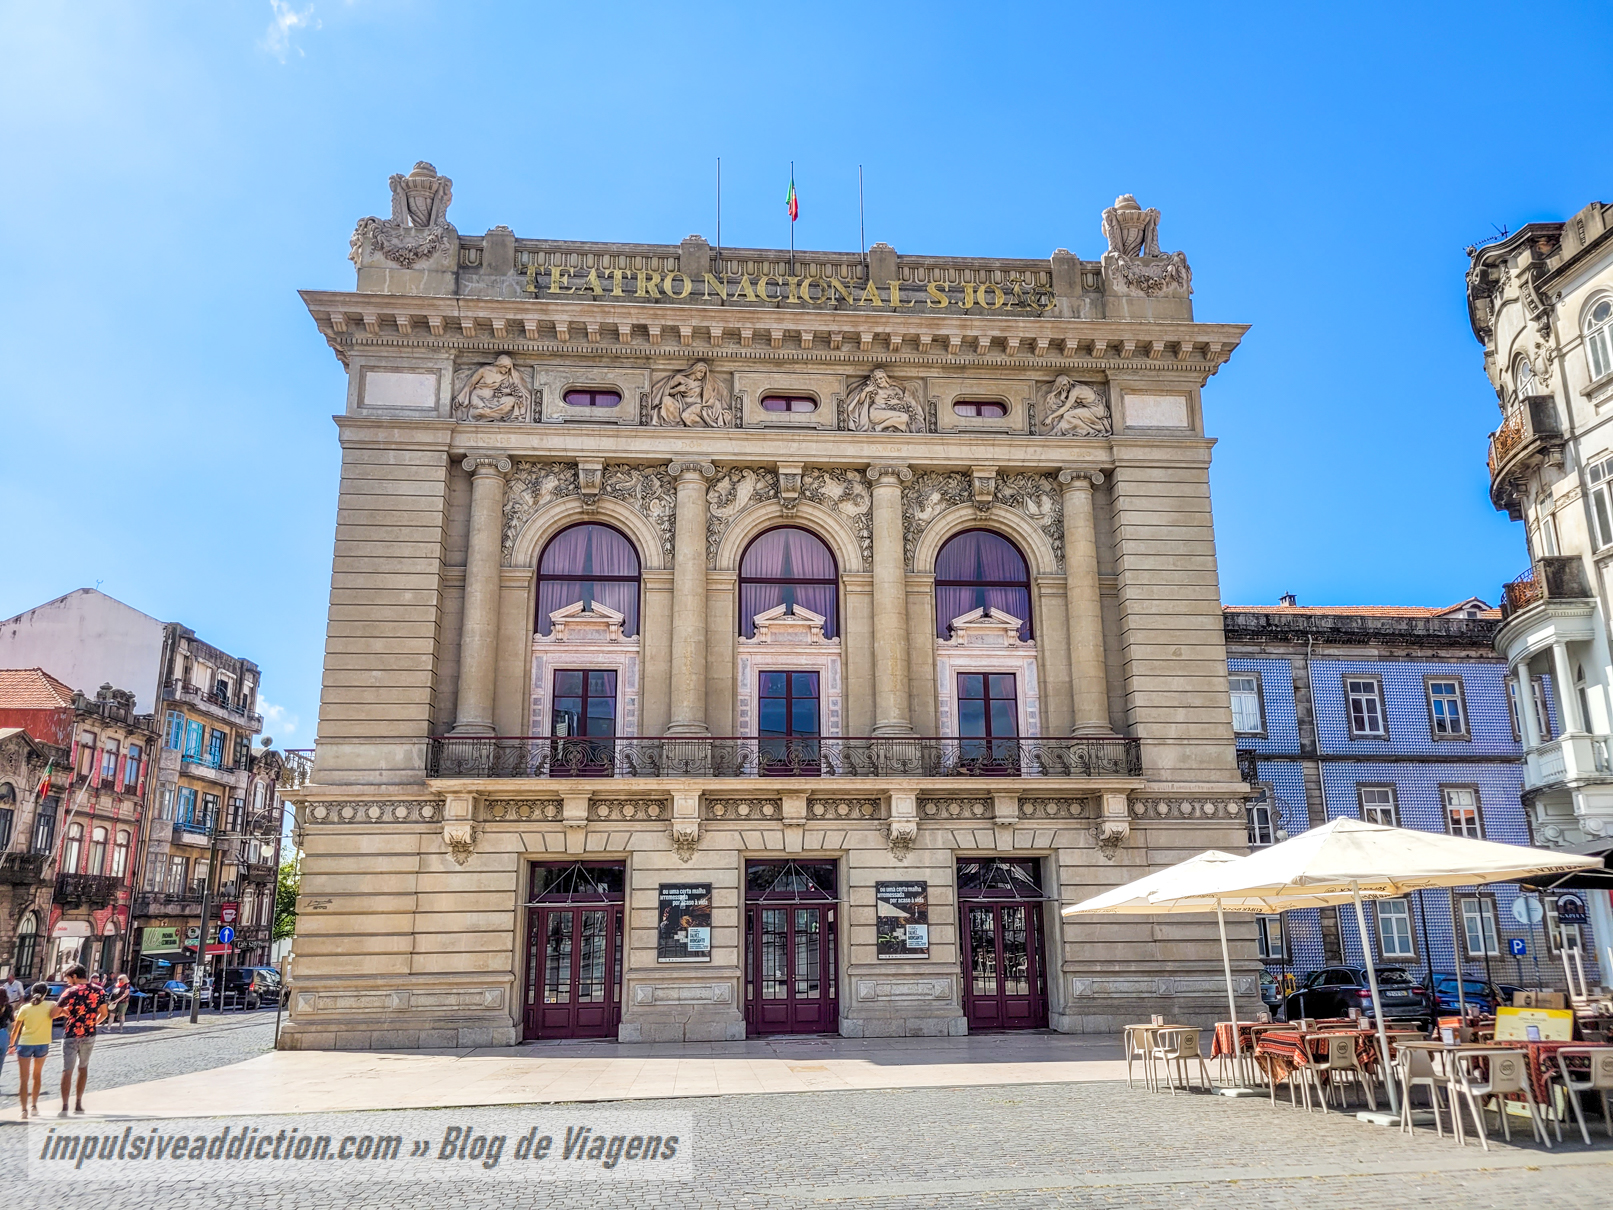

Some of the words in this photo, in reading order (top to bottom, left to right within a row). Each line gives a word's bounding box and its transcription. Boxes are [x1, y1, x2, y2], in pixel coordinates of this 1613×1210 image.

[518, 264, 693, 300] TEATRO
[702, 271, 915, 309] NACIONAL
[1512, 940, 1523, 954] P
